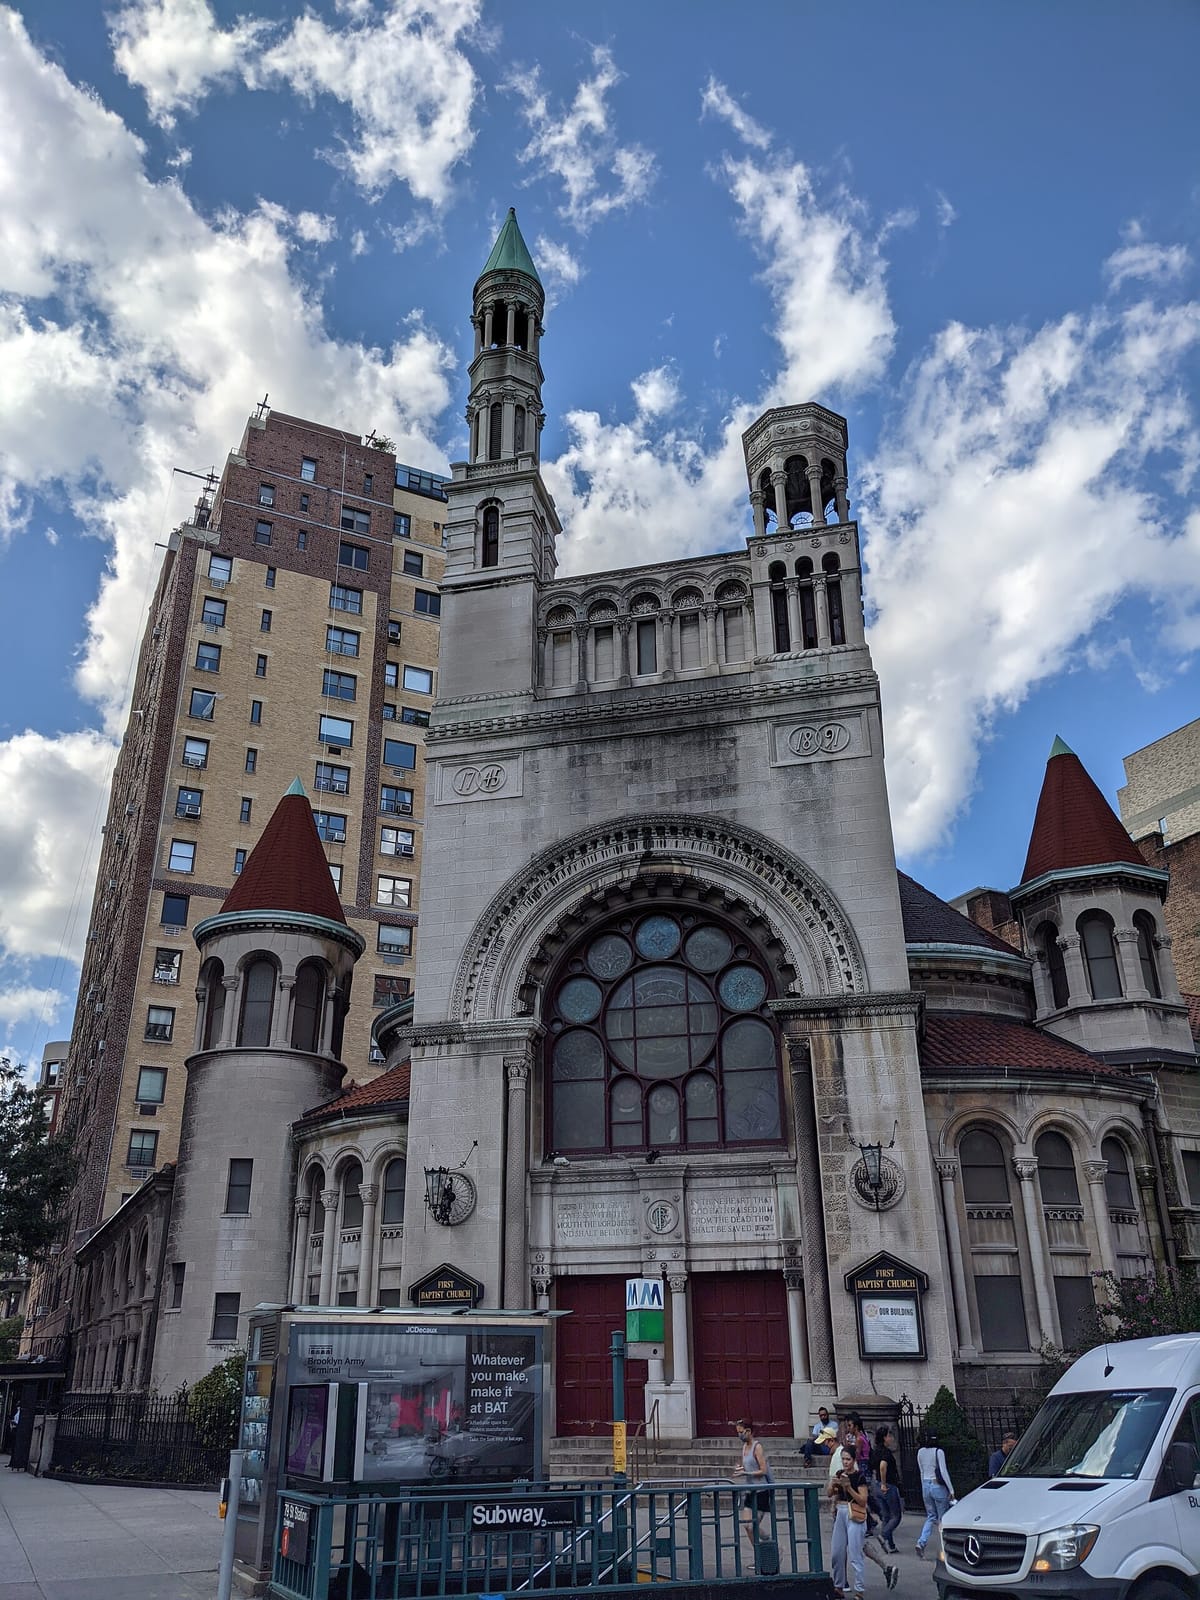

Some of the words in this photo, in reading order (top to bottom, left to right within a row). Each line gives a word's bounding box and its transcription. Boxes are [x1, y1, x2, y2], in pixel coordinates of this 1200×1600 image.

[875, 1269, 895, 1278] FIRST
[437, 1280, 455, 1289] FIRST
[857, 1280, 885, 1289] BAPTIST
[887, 1279, 916, 1288] CHURCH
[420, 1291, 444, 1299] BAPTIST
[446, 1289, 471, 1299] CHURCH
[879, 1307, 890, 1316] OUR
[890, 1307, 914, 1317] BUILDING
[405, 1326, 438, 1334] JCDecaux
[307, 1357, 343, 1366] Brooklyn
[344, 1357, 366, 1367] Army
[471, 1354, 525, 1365] Whatever
[307, 1366, 341, 1374] Terminal
[471, 1372, 492, 1384] you
[495, 1370, 529, 1383] make,
[470, 1386, 502, 1397] make
[505, 1386, 512, 1397] it
[470, 1402, 482, 1413] at
[485, 1401, 508, 1413] BAT
[284, 1503, 290, 1517] 79
[294, 1505, 307, 1522] Station
[472, 1505, 544, 1527] Subway
